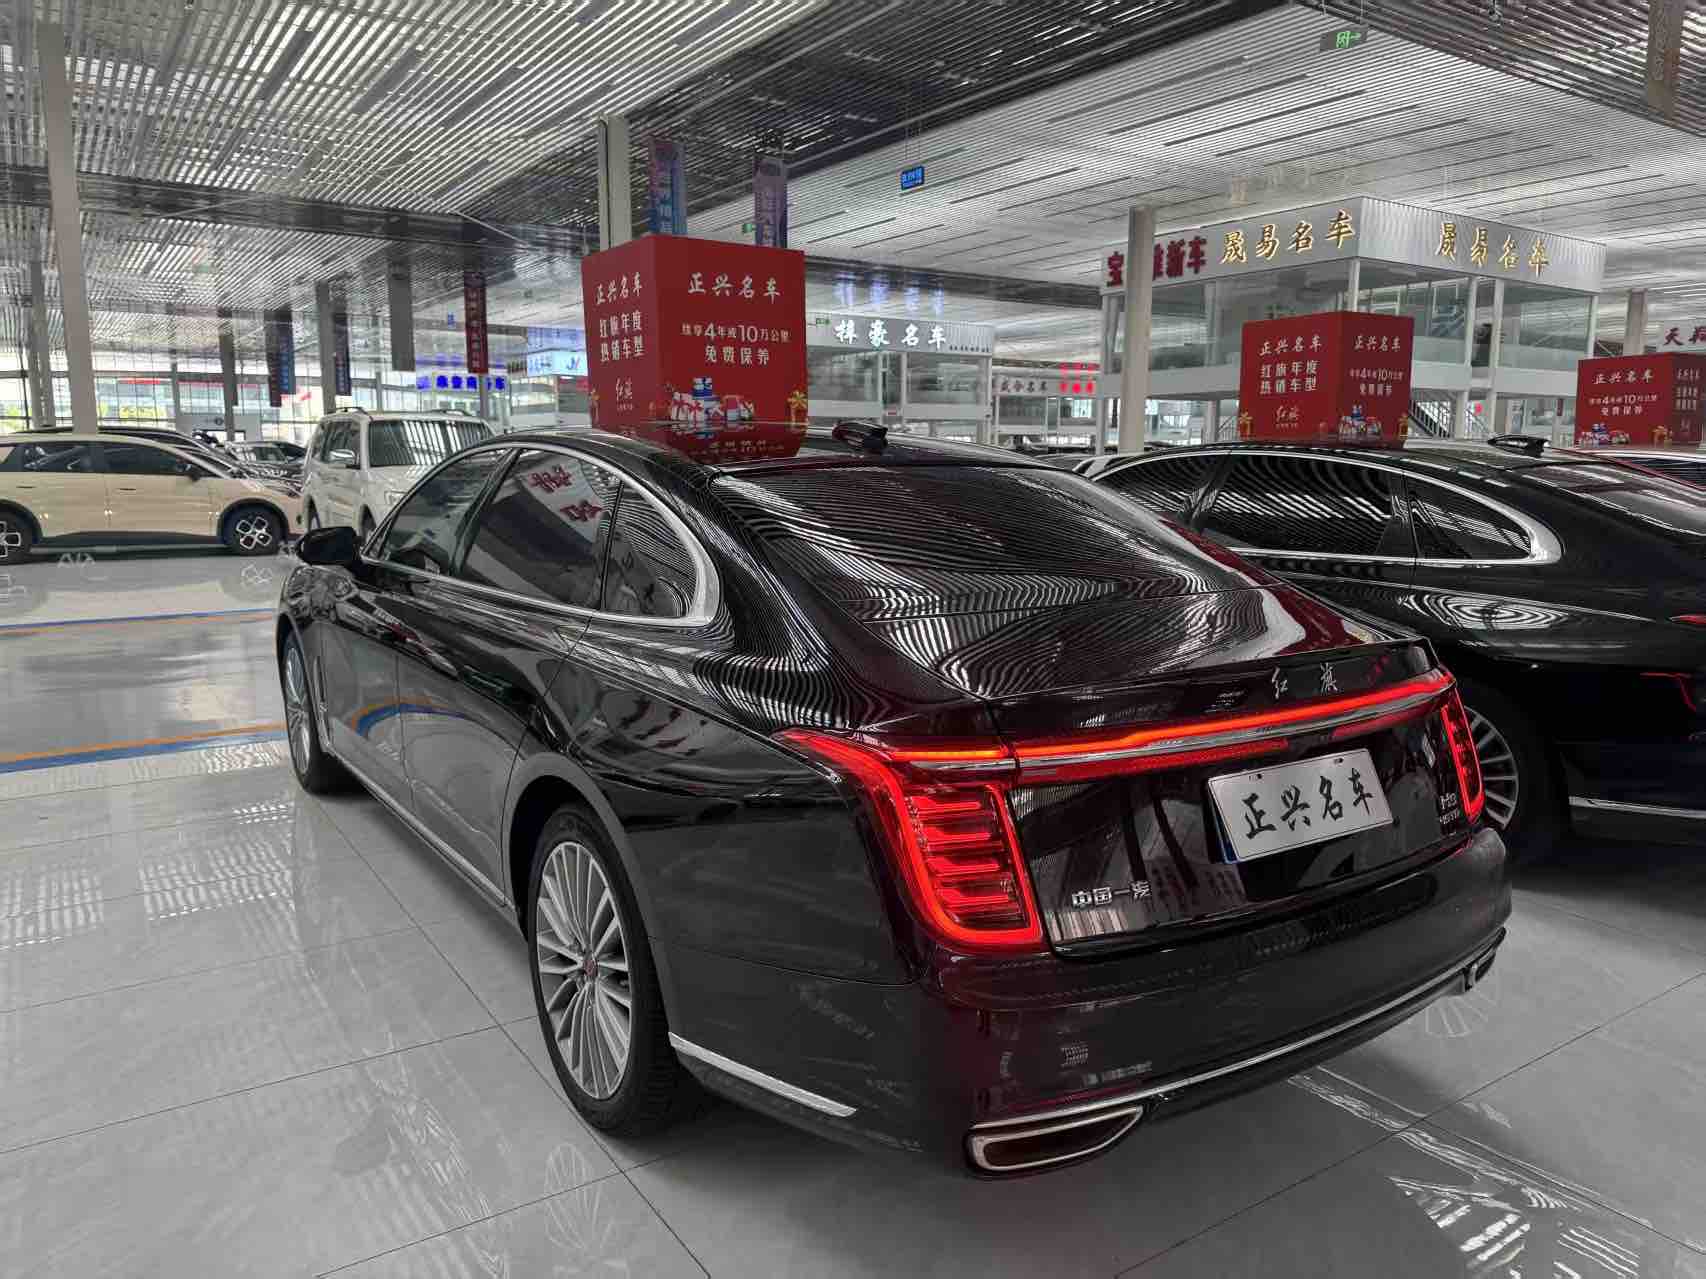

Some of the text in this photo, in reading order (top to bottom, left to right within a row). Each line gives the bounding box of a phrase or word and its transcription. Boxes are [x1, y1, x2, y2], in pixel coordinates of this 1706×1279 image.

[1219, 209, 1355, 263] 晟易名车
[1435, 222, 1548, 277] 晟易名车
[1107, 237, 1206, 287] 宝新车
[596, 271, 642, 305] 正兴名车
[688, 273, 781, 304] 正兴名车
[705, 345, 770, 365] 免费保养
[1259, 334, 1322, 357] 正兴名车
[1354, 335, 1400, 352] 正兴名车
[1593, 368, 1653, 385] 正兴名车
[1241, 768, 1373, 840] 正兴名车
[1071, 880, 1151, 906] 中国一汽
